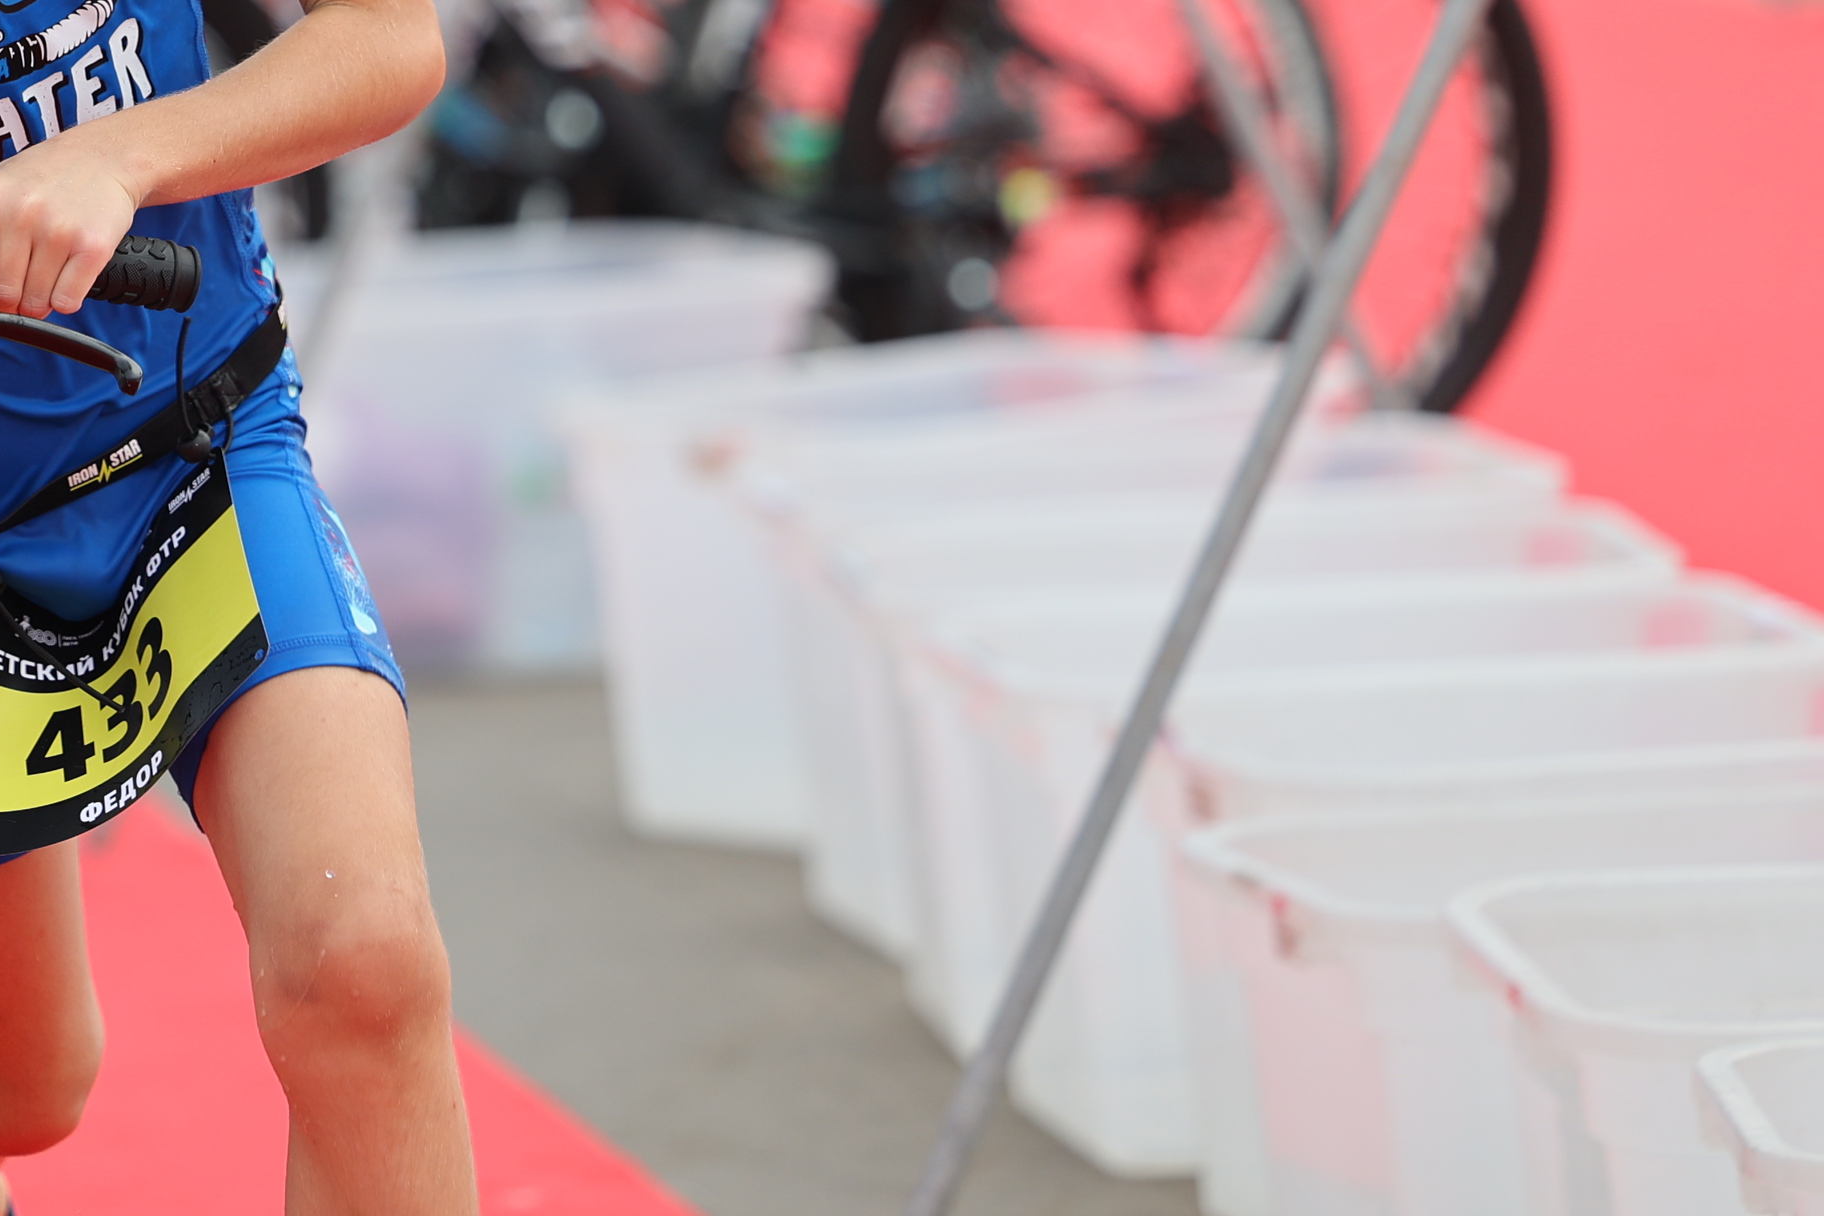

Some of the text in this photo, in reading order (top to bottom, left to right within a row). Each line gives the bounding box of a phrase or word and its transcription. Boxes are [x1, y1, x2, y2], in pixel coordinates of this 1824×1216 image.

[67, 439, 142, 487] IRON STAR
[168, 467, 212, 512] IRON STAR
[101, 575, 145, 662] КУБОК
[146, 525, 187, 578] ФТР
[25, 617, 173, 783] 433
[79, 750, 163, 824] ФЕДОР
